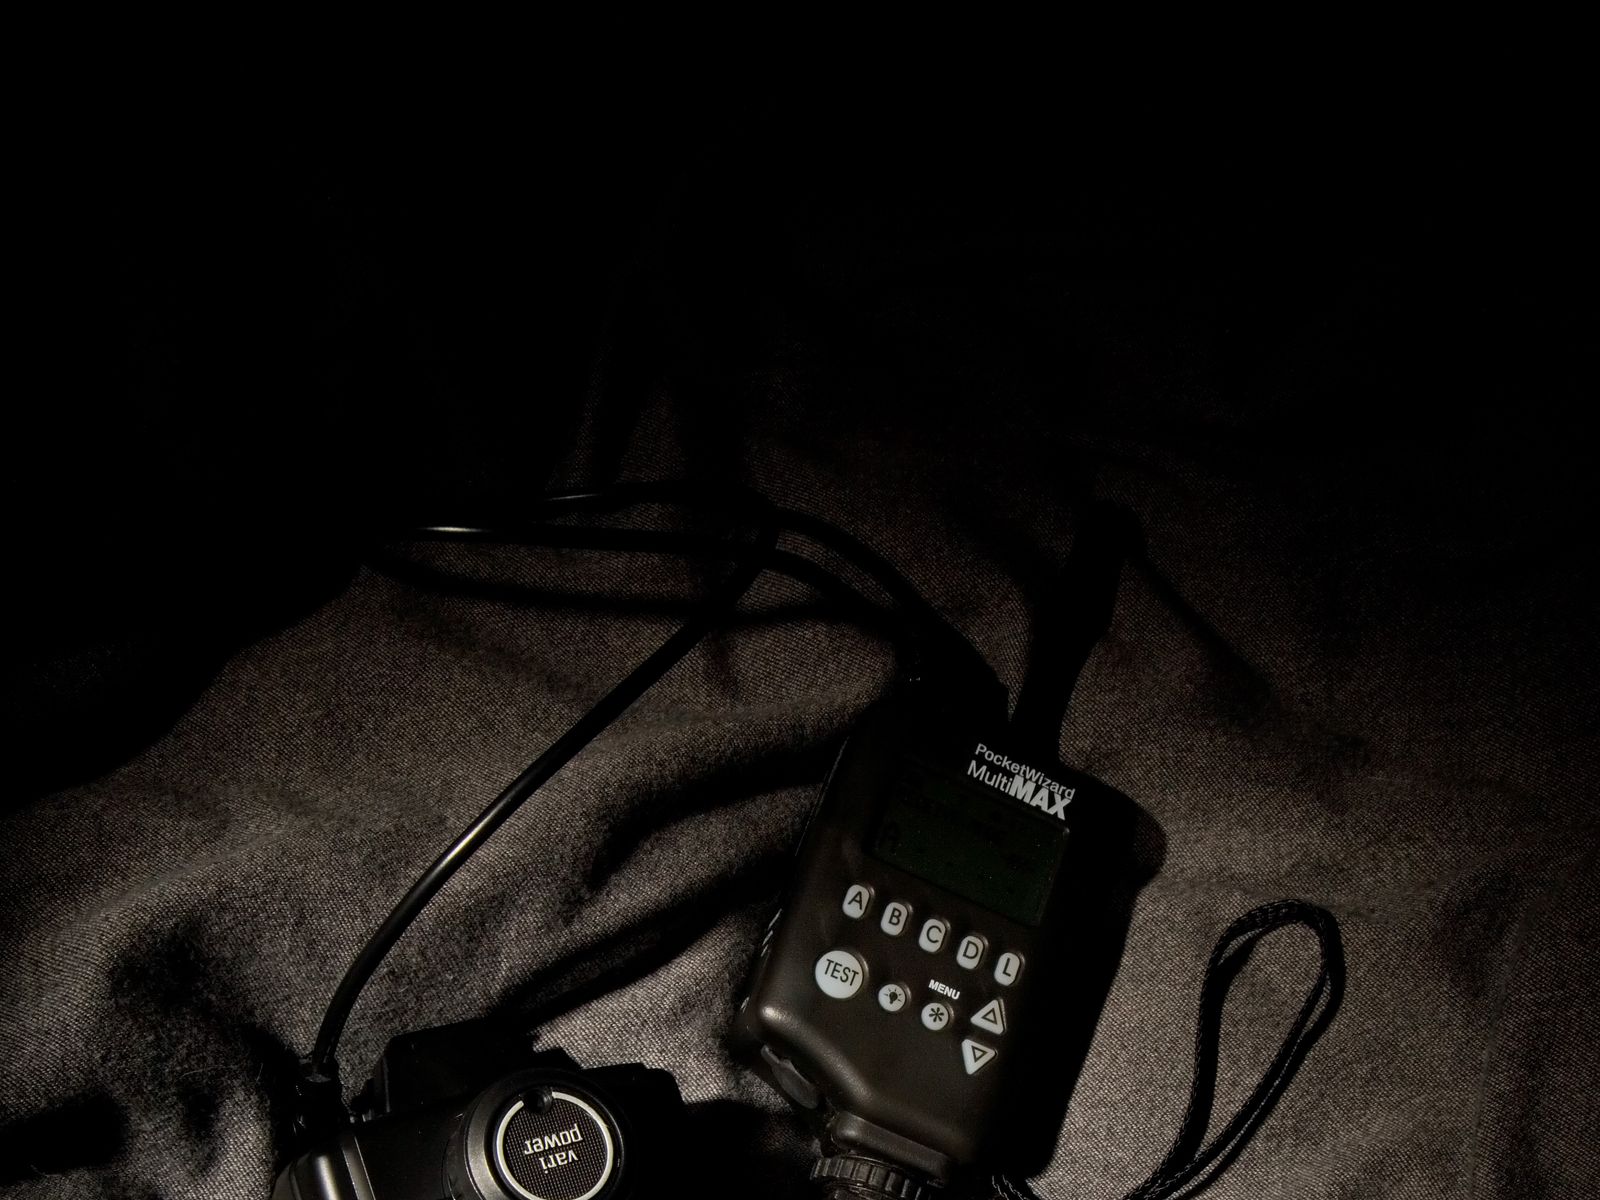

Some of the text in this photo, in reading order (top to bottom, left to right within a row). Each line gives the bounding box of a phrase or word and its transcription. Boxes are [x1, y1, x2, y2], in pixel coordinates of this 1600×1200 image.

[975, 743, 1076, 801] PocketWizard
[967, 760, 1072, 821] MultiMAX
[847, 890, 1012, 978] A B C D L
[823, 958, 860, 987] TEST
[928, 979, 961, 1000] MENU
[524, 1124, 583, 1155] power
[540, 1149, 579, 1174] vari
